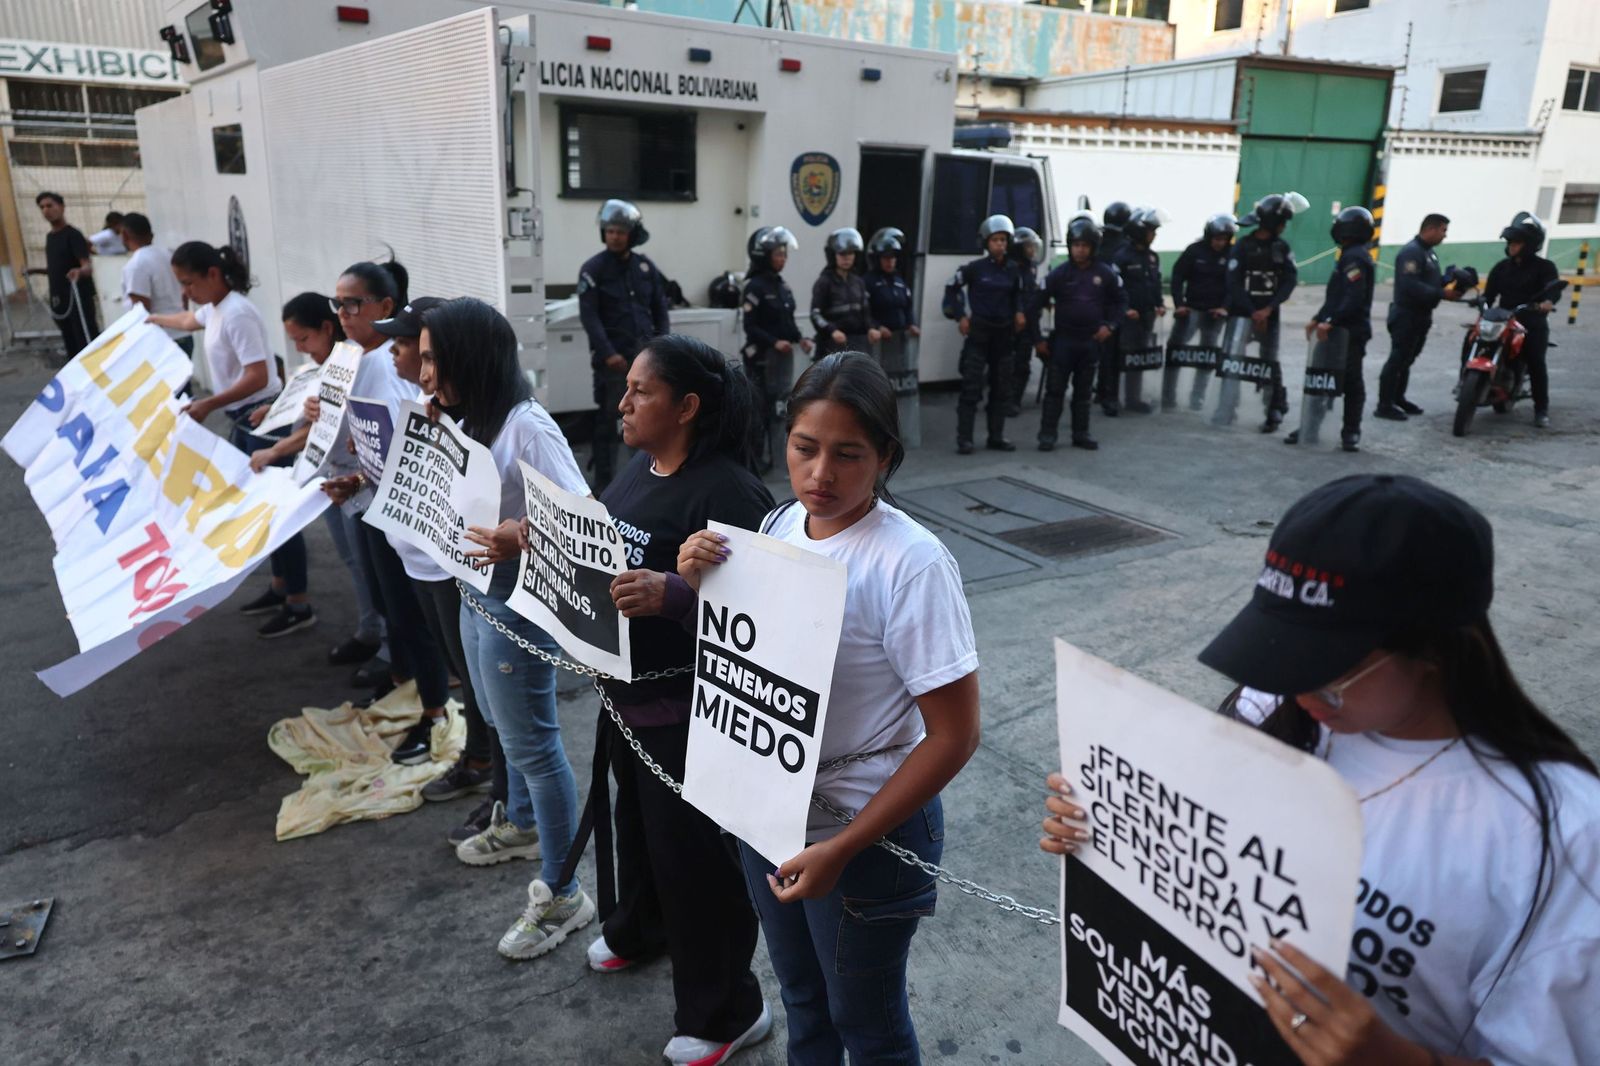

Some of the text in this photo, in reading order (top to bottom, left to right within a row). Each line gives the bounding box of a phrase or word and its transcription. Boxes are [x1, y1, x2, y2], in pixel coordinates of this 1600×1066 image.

[516, 61, 759, 102] LICIA NACIONAL BOLIVARIANA
[326, 363, 355, 384] PRESOS
[1221, 358, 1273, 379] POLICÍA
[1305, 372, 1337, 390] LICÍA
[403, 440, 425, 459] DE
[425, 449, 455, 482] PRESOS
[408, 418, 465, 468] LAS MUERTES
[393, 472, 465, 531] BAJO CUSTODIA
[398, 456, 451, 498] POLÍTICOS
[381, 502, 489, 577] HAN INTENSIFICADO
[388, 487, 460, 545] DEL ESTADO SE
[526, 478, 617, 545] PENSAR DISTINTO
[528, 500, 617, 570] NO ES UN DELITO.
[617, 520, 652, 546] TODOS
[527, 526, 577, 586] AISLARLOS Y
[529, 548, 597, 621] TORTURARLOS,
[524, 568, 559, 613] SÍ LO ES
[702, 599, 756, 652] NO
[702, 649, 807, 722] TENEMOS
[694, 684, 806, 774] MIEDO
[1089, 744, 1298, 888] ¡FRENTE AL
[1080, 763, 1310, 932] SILENCIO, LA
[1091, 801, 1248, 932] CENSURA
[1092, 826, 1127, 871] EL
[1069, 912, 1248, 1066] SOLIDARID
[1140, 940, 1212, 1020] MÁS
[1096, 961, 1217, 1066] VERDA
